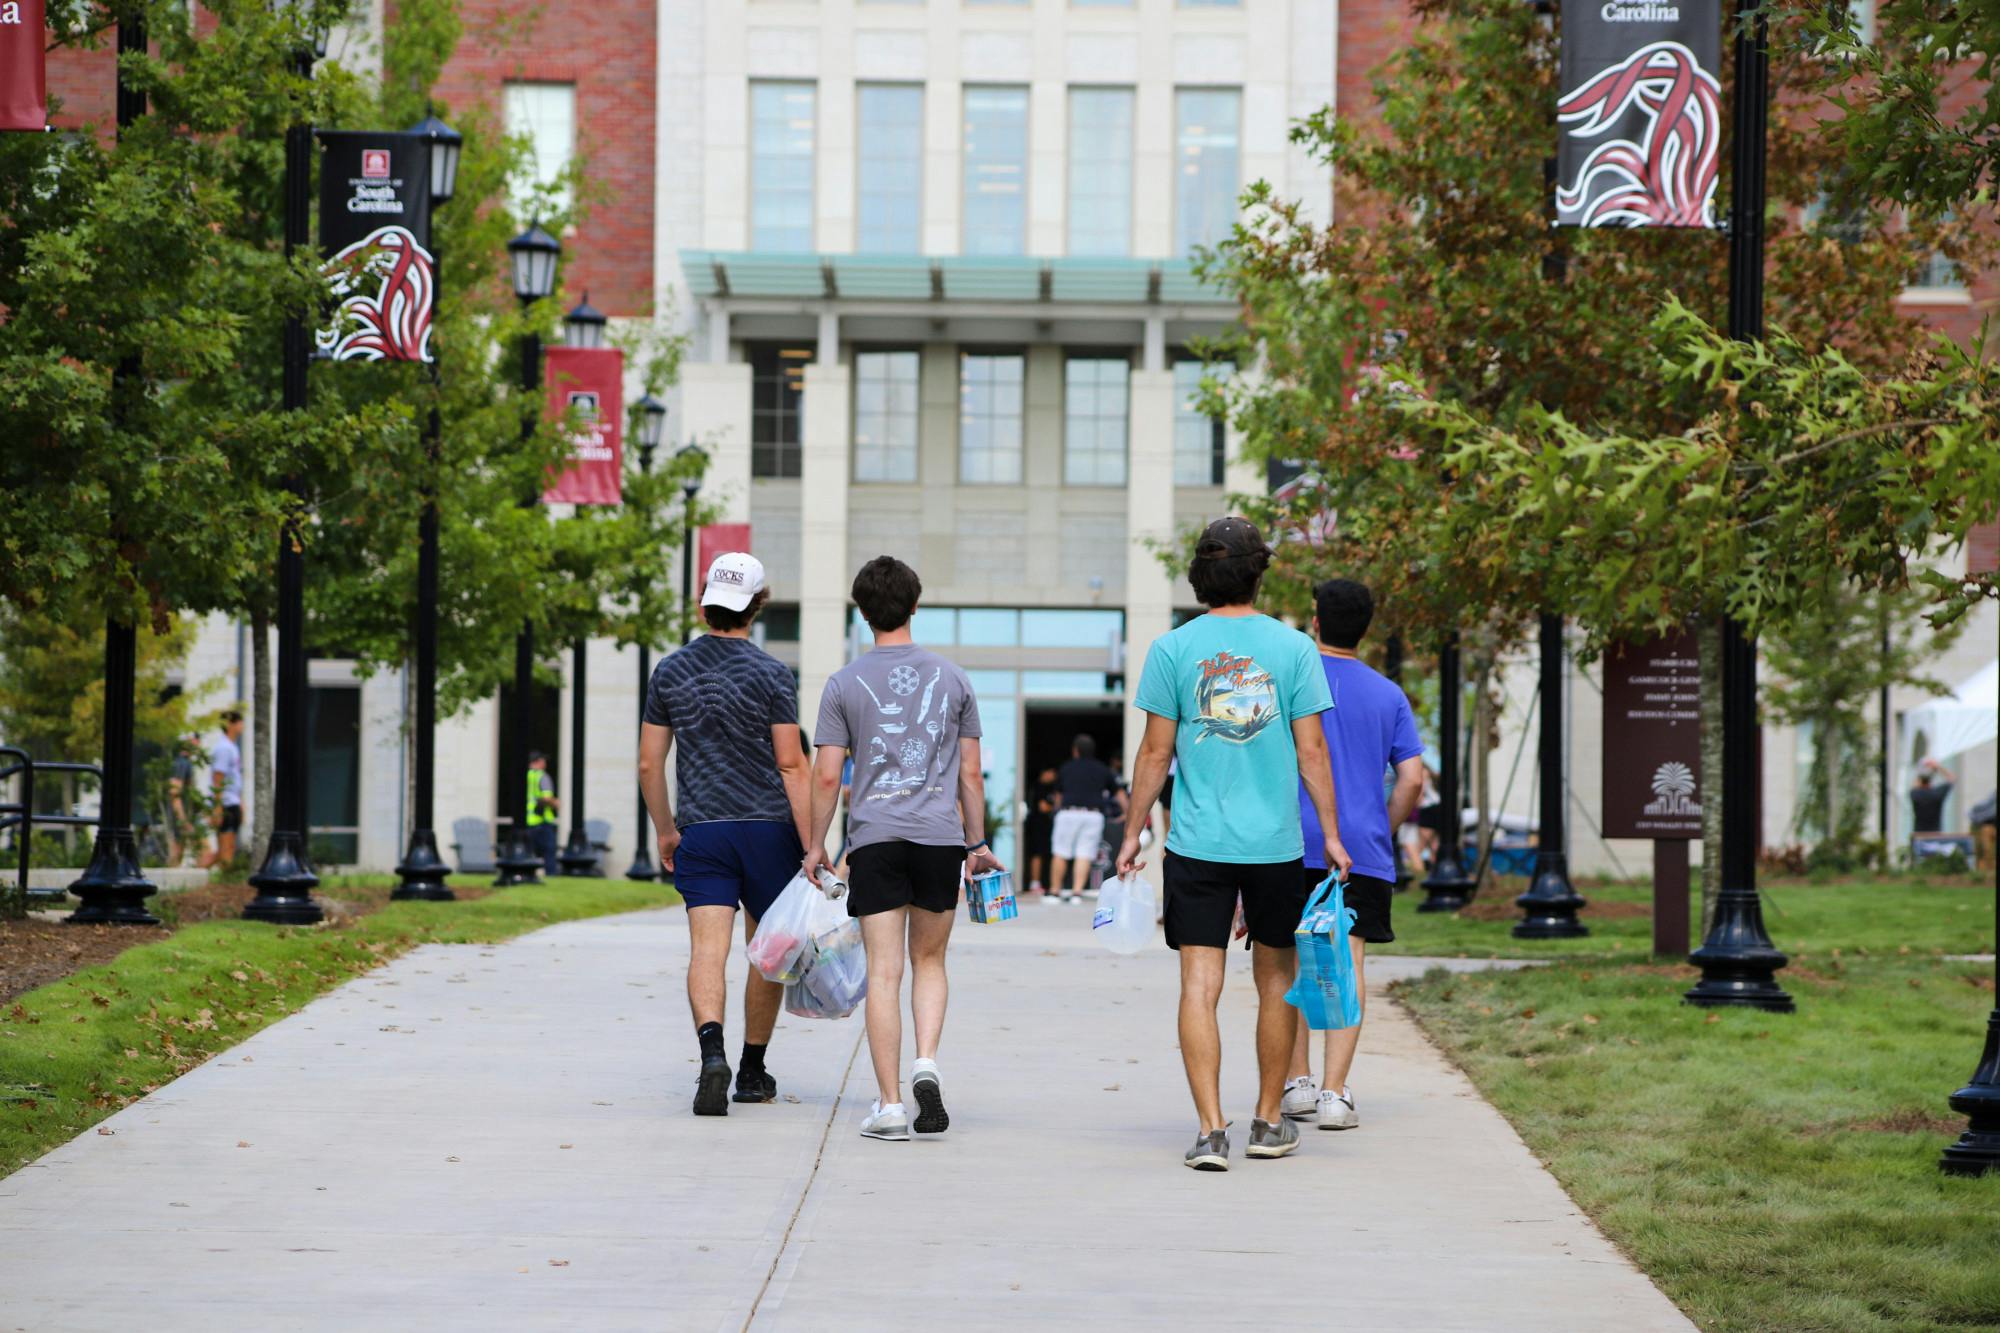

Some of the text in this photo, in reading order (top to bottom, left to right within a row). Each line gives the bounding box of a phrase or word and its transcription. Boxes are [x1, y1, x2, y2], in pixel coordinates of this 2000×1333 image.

[1600, 3, 1680, 22] Carolina
[356, 185, 395, 199] South
[347, 198, 403, 213] Carolina
[714, 568, 744, 582] COCKS
